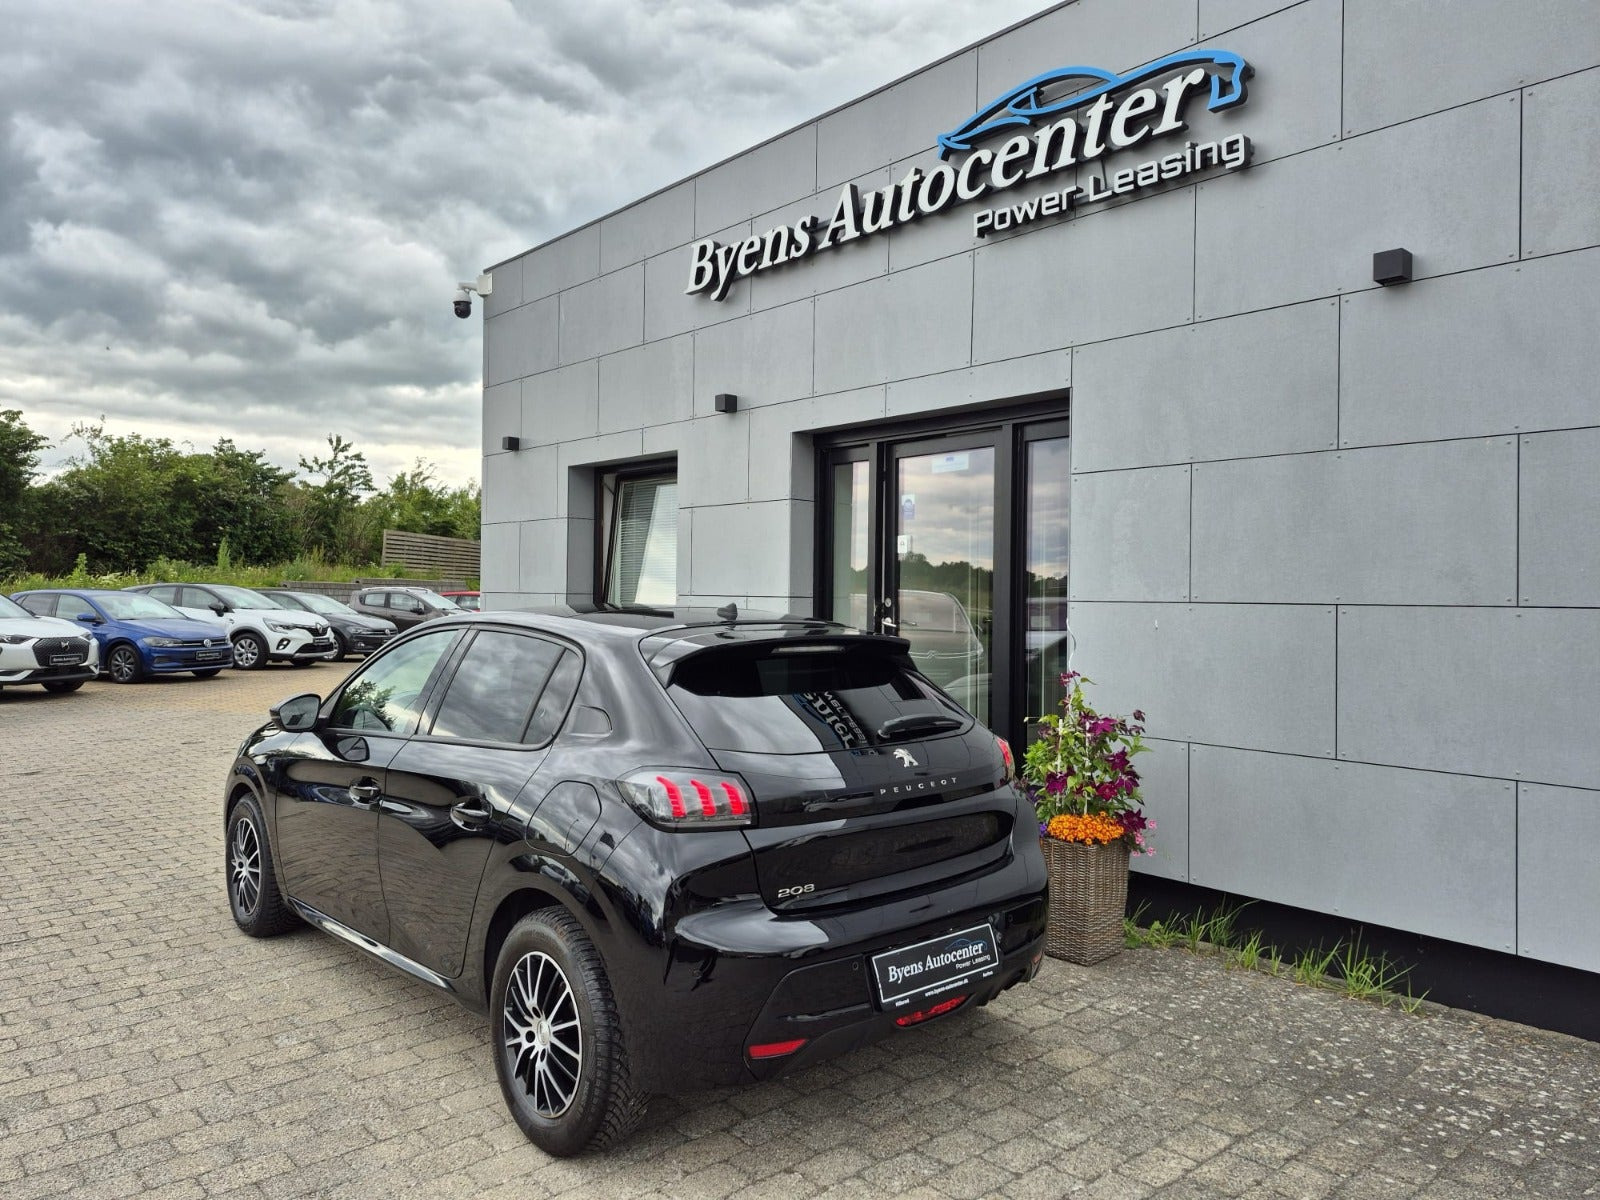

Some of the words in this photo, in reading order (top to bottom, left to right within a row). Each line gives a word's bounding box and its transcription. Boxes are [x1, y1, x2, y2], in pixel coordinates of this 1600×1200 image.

[685, 214, 812, 300] Byens
[817, 67, 1204, 250] Autocenter
[973, 185, 1077, 238] Power
[1088, 133, 1246, 202] Leasing
[879, 777, 957, 796] PEUGEOT
[777, 883, 815, 899] 208
[888, 961, 923, 983] Byens
[925, 942, 983, 971] Autocenter
[955, 960, 972, 970] Power
